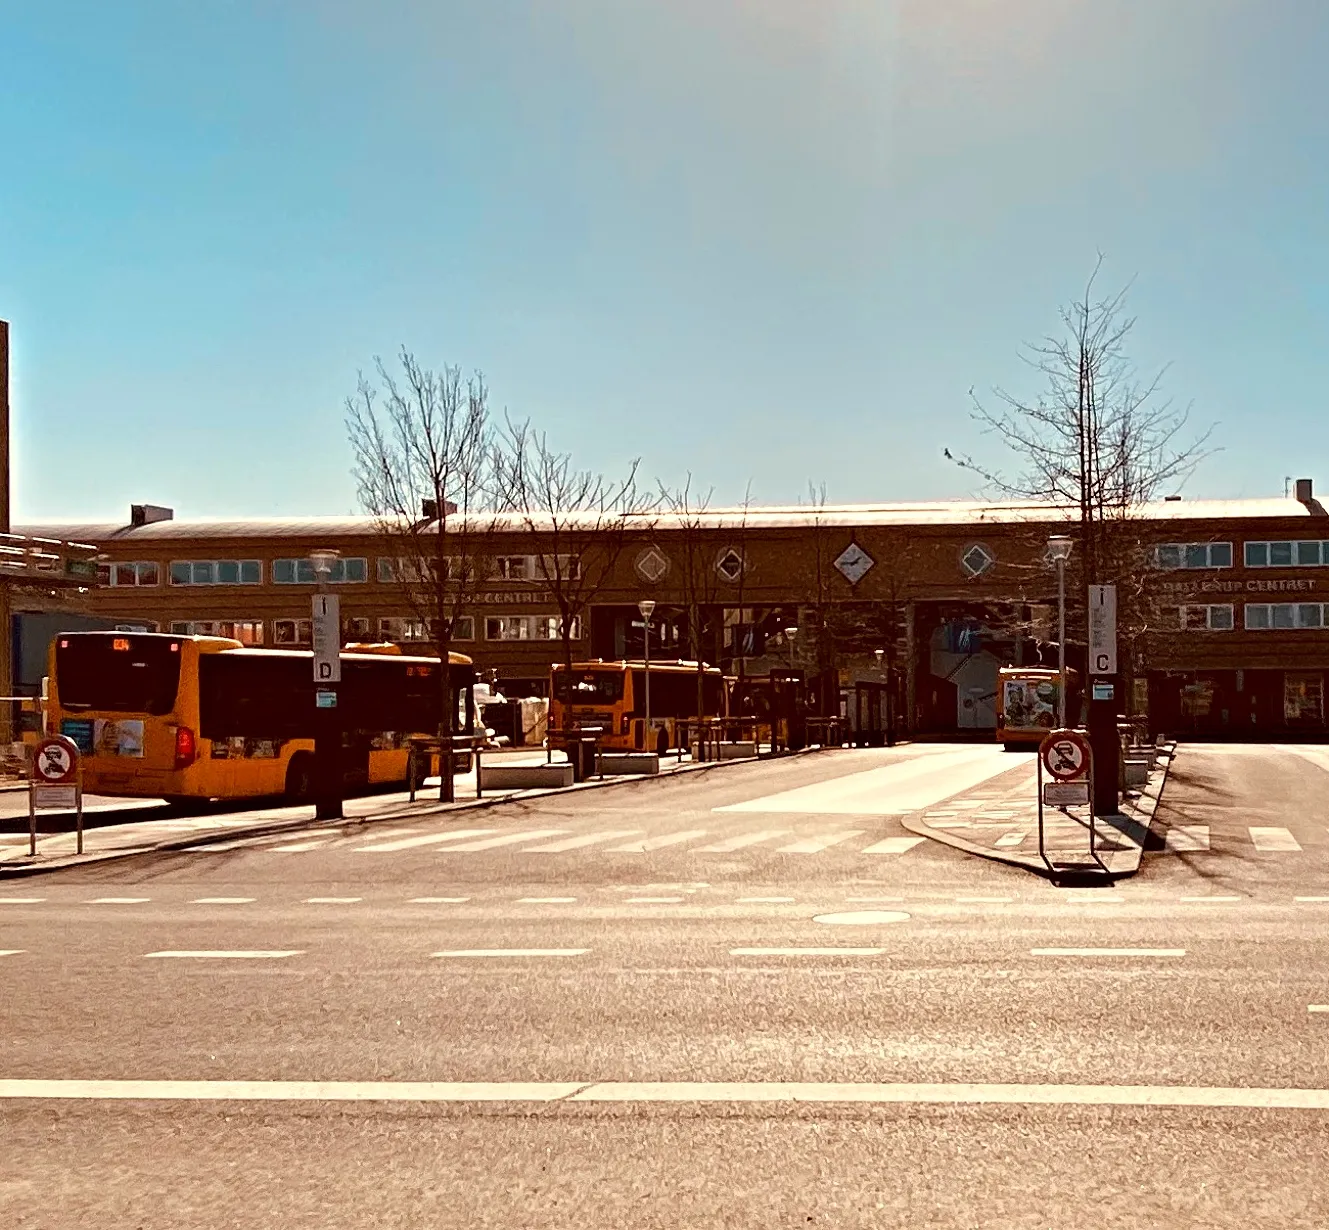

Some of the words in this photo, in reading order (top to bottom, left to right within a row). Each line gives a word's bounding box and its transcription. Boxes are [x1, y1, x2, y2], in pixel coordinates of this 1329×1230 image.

[1246, 579, 1317, 592] CENTRET
[320, 662, 332, 679] D
[1096, 653, 1109, 672] C
